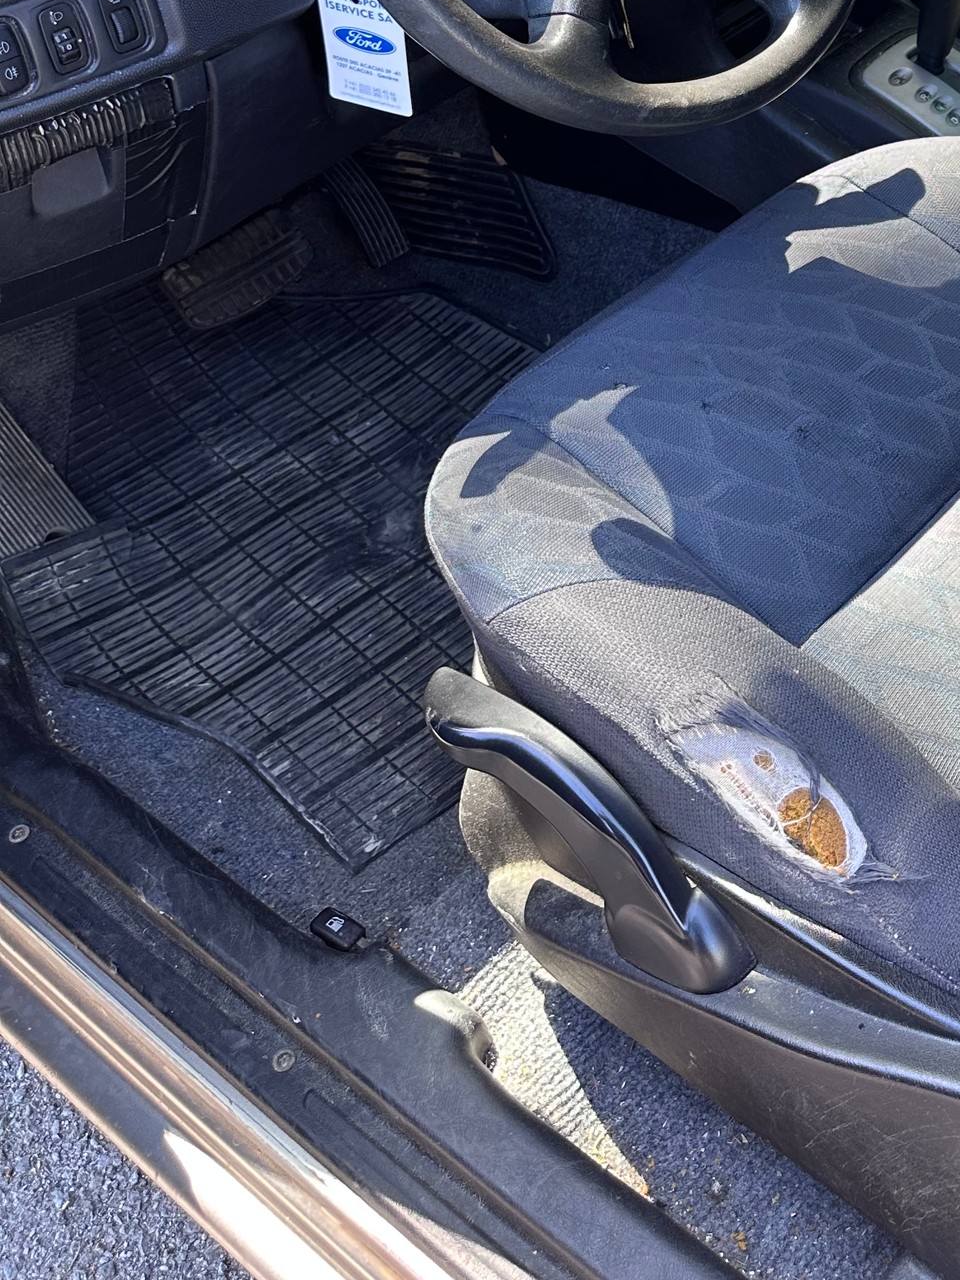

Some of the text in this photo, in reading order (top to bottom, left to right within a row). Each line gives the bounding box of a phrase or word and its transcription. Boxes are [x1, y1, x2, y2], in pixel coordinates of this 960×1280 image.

[328, 0, 394, 24] SERVICE SA
[345, 30, 383, 51] Ford
